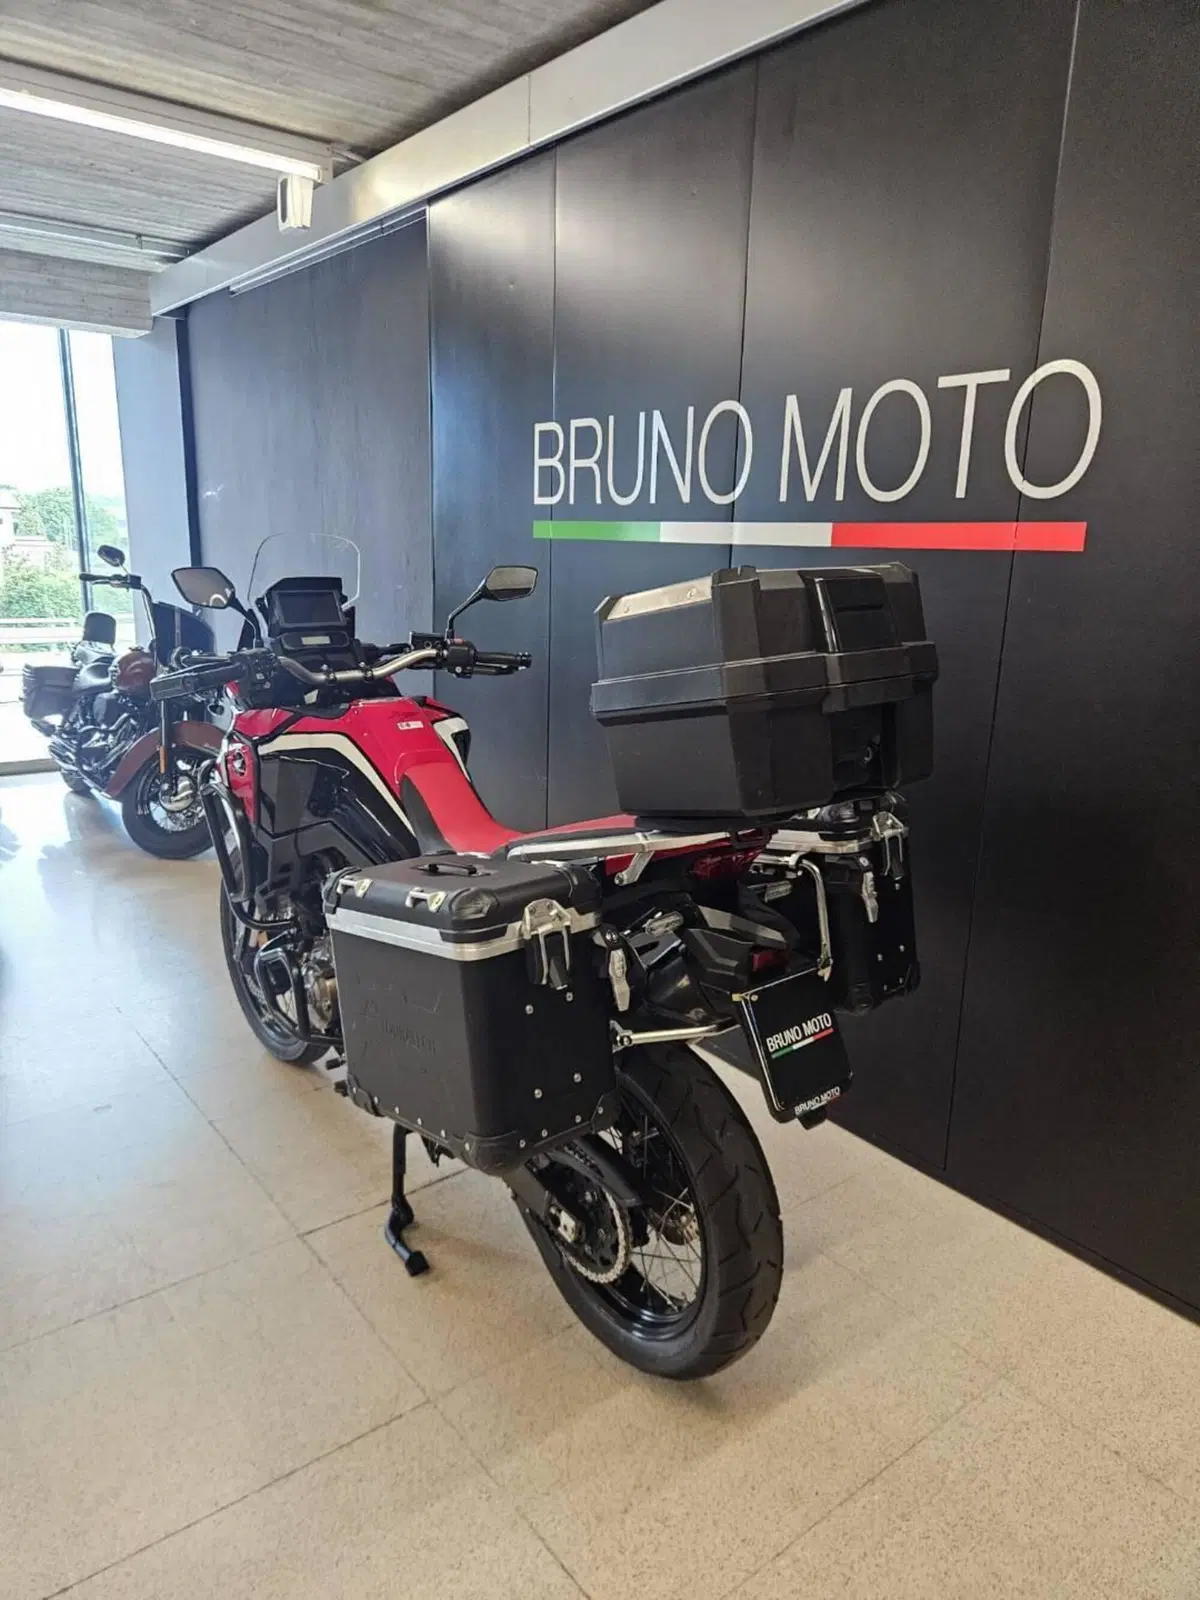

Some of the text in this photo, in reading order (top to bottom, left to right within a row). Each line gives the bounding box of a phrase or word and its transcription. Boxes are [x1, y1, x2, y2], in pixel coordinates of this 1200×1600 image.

[533, 359, 1102, 505] BRUNO MOTO
[766, 1013, 832, 1053] BRUNO MOTO
[794, 1086, 840, 1115] BRUNO MOTO
